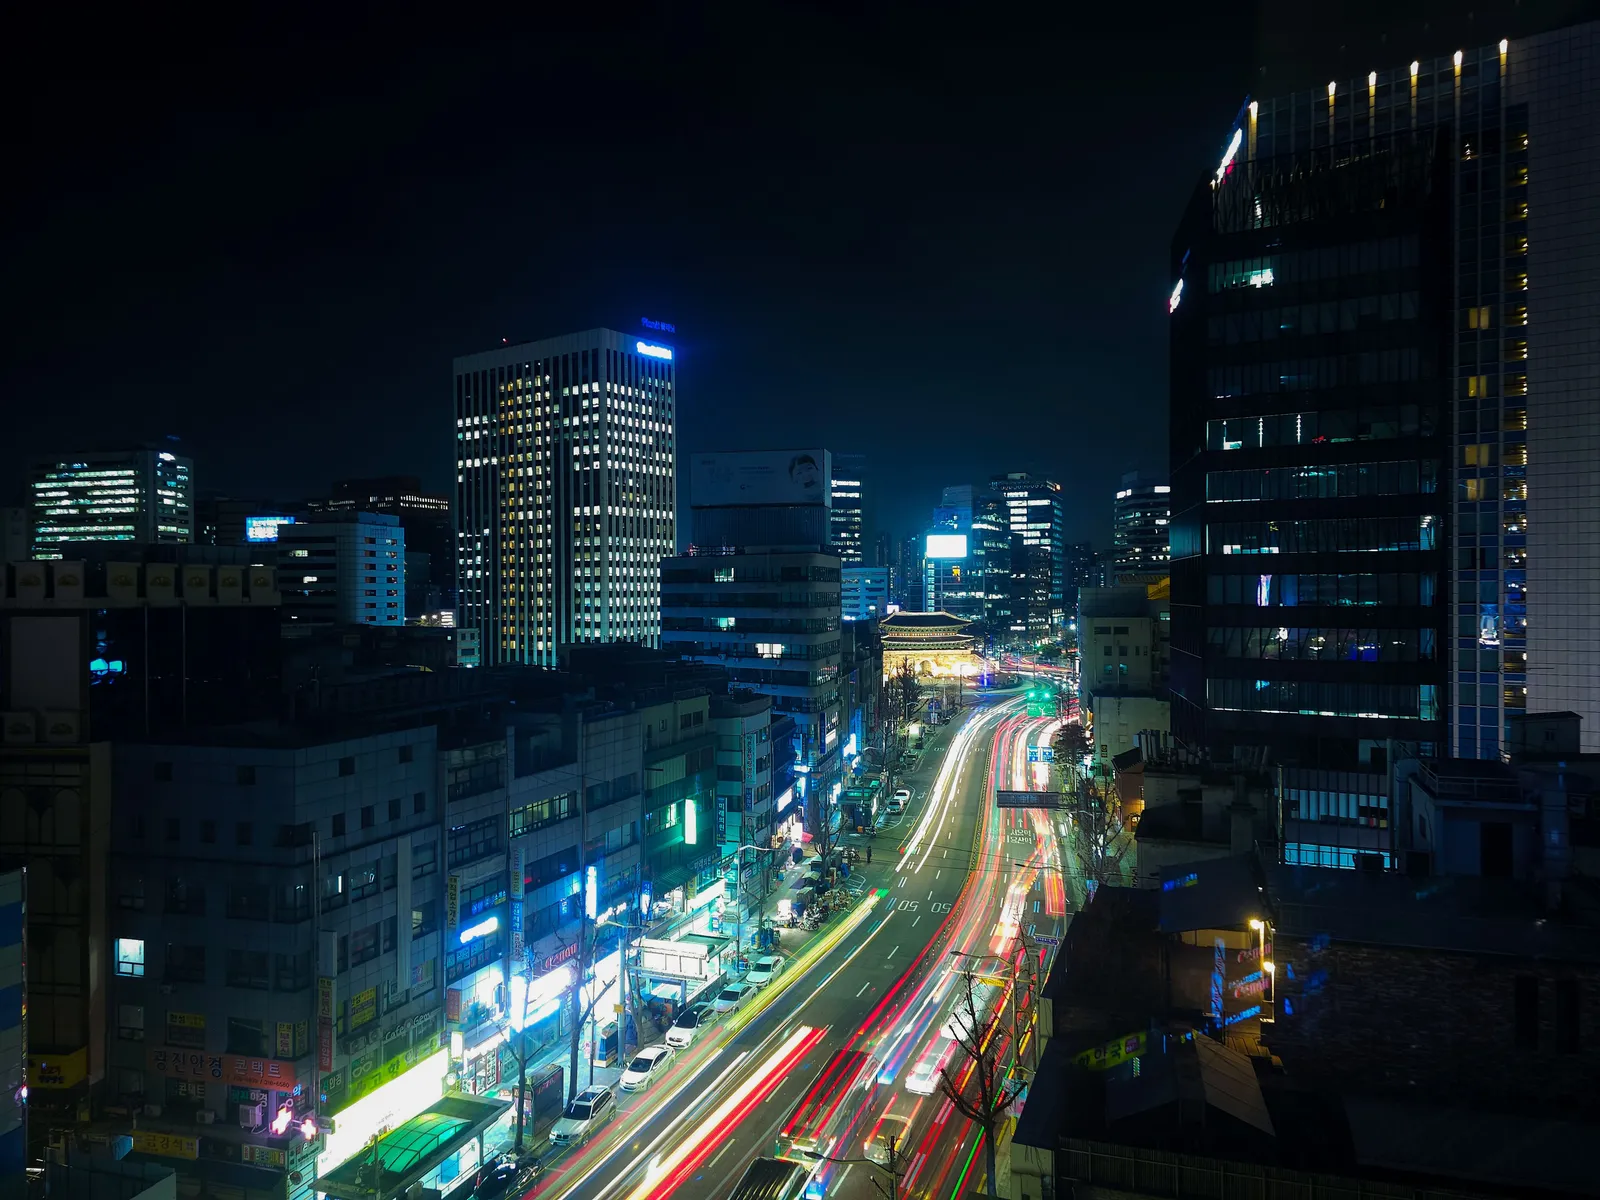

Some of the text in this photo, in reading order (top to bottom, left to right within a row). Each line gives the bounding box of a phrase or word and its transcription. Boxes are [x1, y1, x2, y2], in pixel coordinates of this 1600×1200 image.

[897, 900, 919, 912] 50
[930, 902, 953, 914] 50
[545, 943, 578, 968] Canon
[153, 1050, 222, 1078] 광진안경
[234, 1059, 281, 1079] 콘택트
